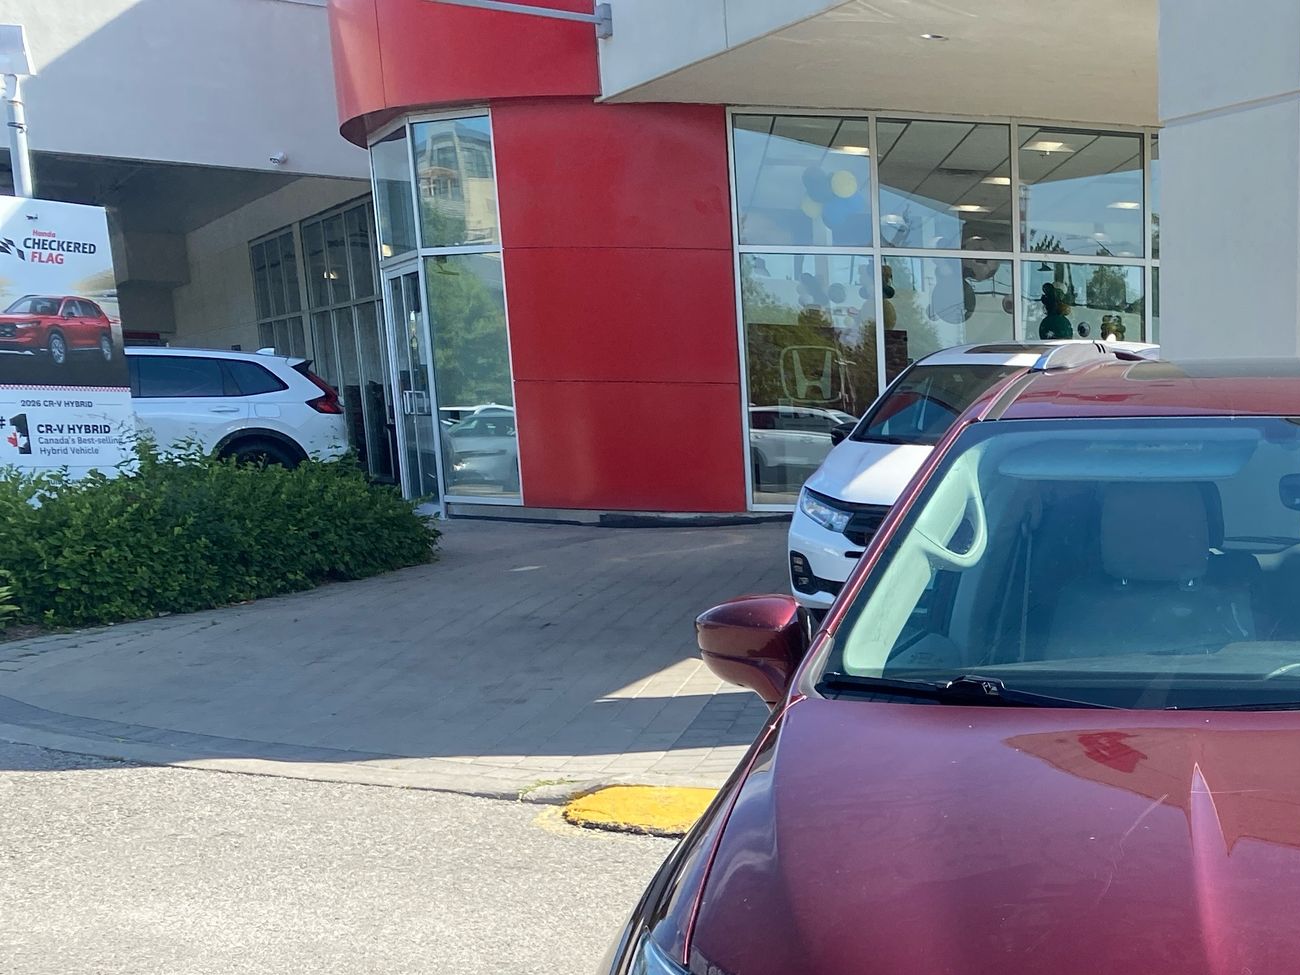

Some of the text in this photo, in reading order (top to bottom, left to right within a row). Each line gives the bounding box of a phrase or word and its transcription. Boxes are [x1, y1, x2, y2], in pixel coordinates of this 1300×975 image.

[32, 229, 56, 238] Honda
[23, 237, 97, 255] CHECKERED
[31, 251, 64, 265] FLAG
[20, 399, 41, 408] 2026
[37, 424, 111, 434] CR-V HYBRID
[38, 436, 75, 445] Canada's
[40, 447, 99, 457] Hybrid Vehicle
